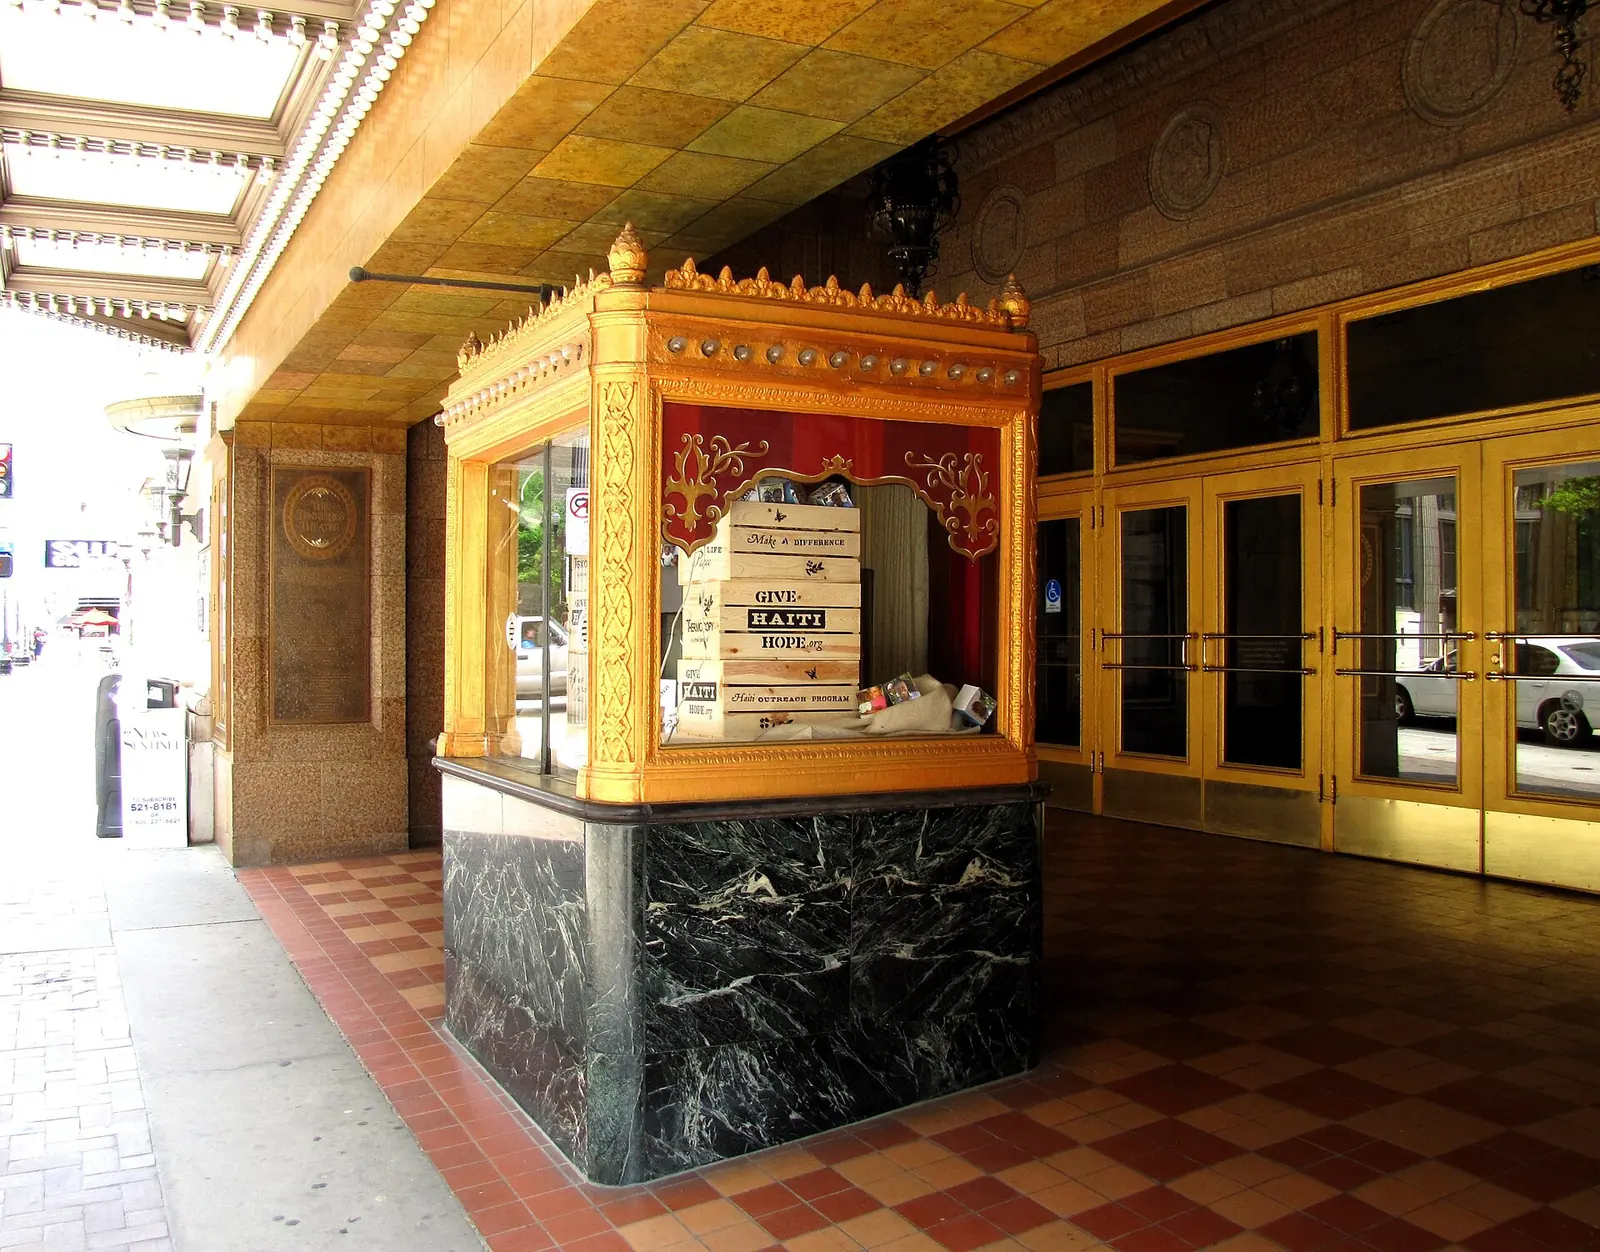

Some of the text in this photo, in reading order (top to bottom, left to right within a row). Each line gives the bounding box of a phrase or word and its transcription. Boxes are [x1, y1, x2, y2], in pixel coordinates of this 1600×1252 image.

[747, 534, 776, 549] Make
[706, 546, 723, 554] LIFE
[755, 590, 796, 603] GIVE
[751, 612, 822, 626] HAITI
[685, 669, 701, 679] GIVE
[683, 685, 716, 699] HAITI
[731, 693, 756, 702] Haiti
[130, 803, 177, 811] 521-8181
